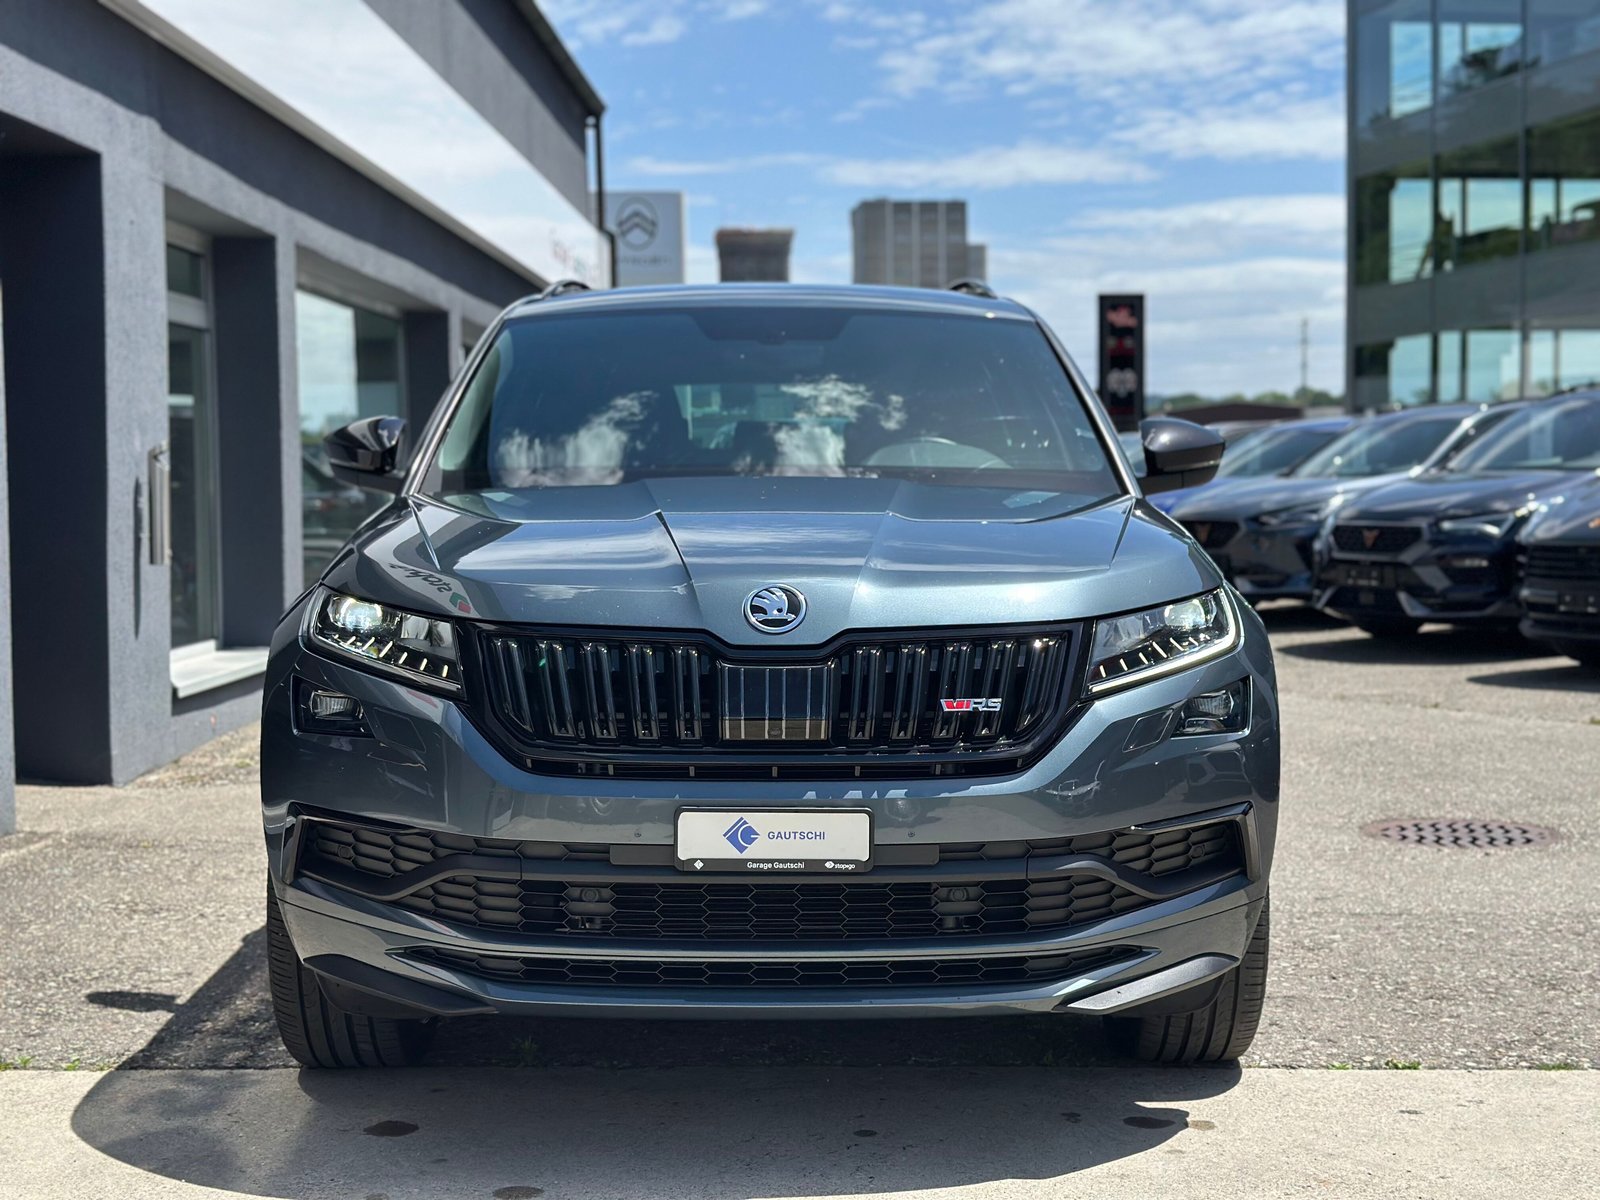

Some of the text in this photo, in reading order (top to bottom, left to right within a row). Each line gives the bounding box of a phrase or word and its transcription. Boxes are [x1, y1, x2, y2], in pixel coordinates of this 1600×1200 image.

[767, 831, 826, 840] GAUTSCHI
[747, 861, 805, 870] Garage Gautschi
